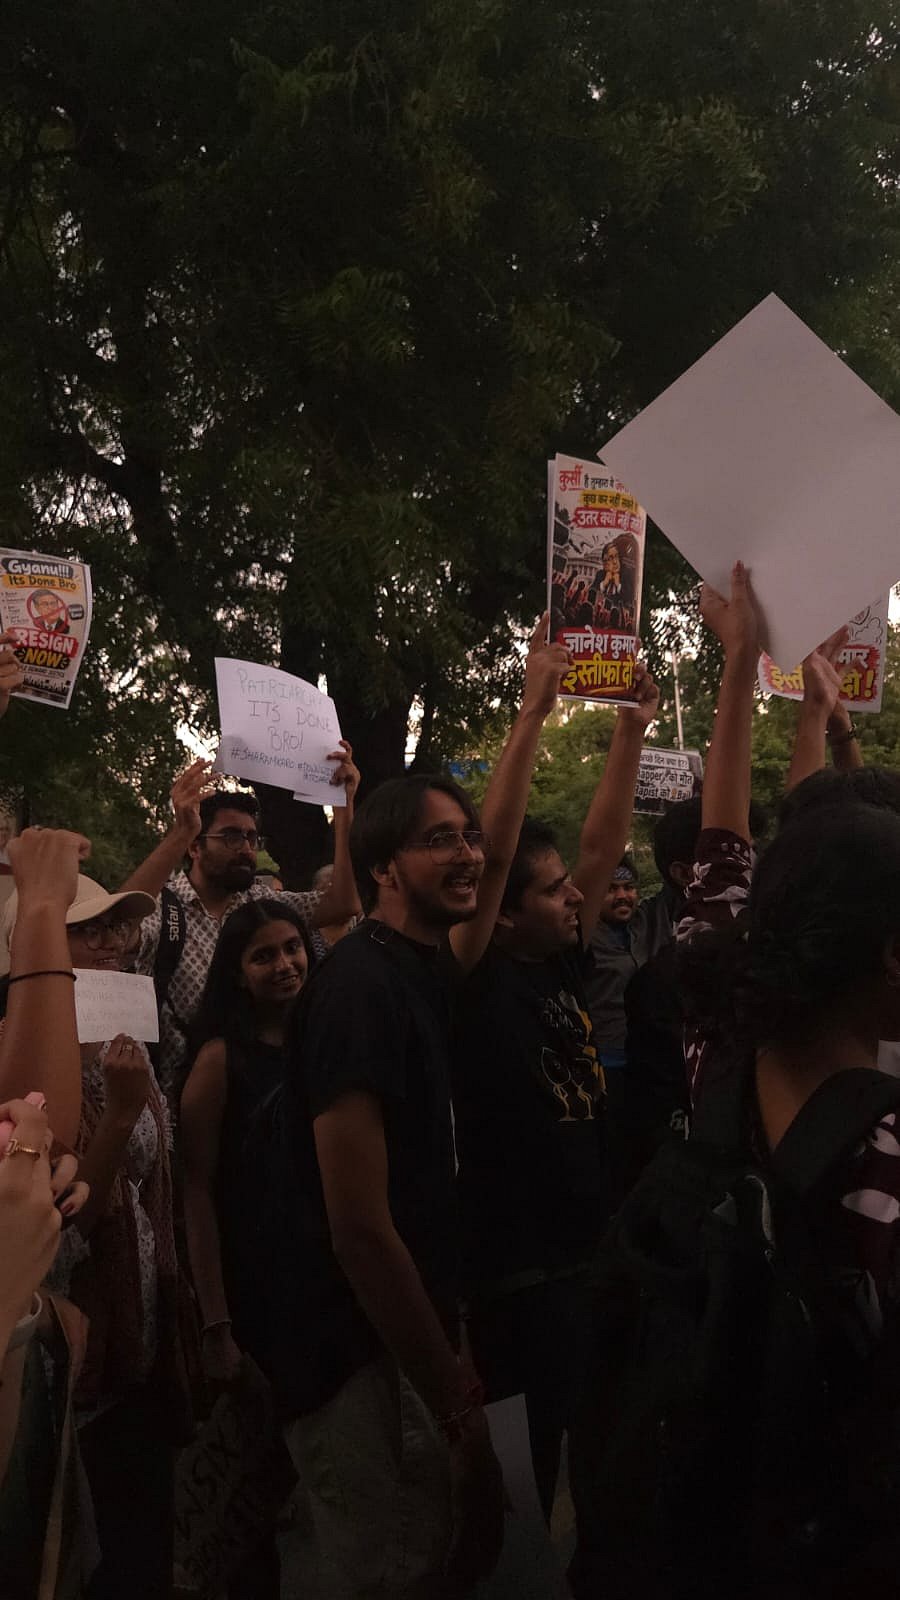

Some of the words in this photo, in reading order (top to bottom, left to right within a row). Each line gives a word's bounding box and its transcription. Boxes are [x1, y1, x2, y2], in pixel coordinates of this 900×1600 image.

[560, 465, 583, 491] कुर्सी
[577, 510, 599, 526] उतर
[600, 508, 617, 526] क्यों
[8, 559, 70, 577] Gyanu!!!
[9, 575, 25, 586] Its
[29, 576, 56, 587] Done
[59, 578, 77, 590] Bro
[16, 629, 74, 655] RESIGN
[611, 634, 636, 659] कुमार
[24, 647, 62, 668] NOW
[296, 707, 333, 732] DONE
[268, 726, 304, 752] BRO!
[638, 770, 666, 784] apper,
[168, 904, 179, 941] safari
